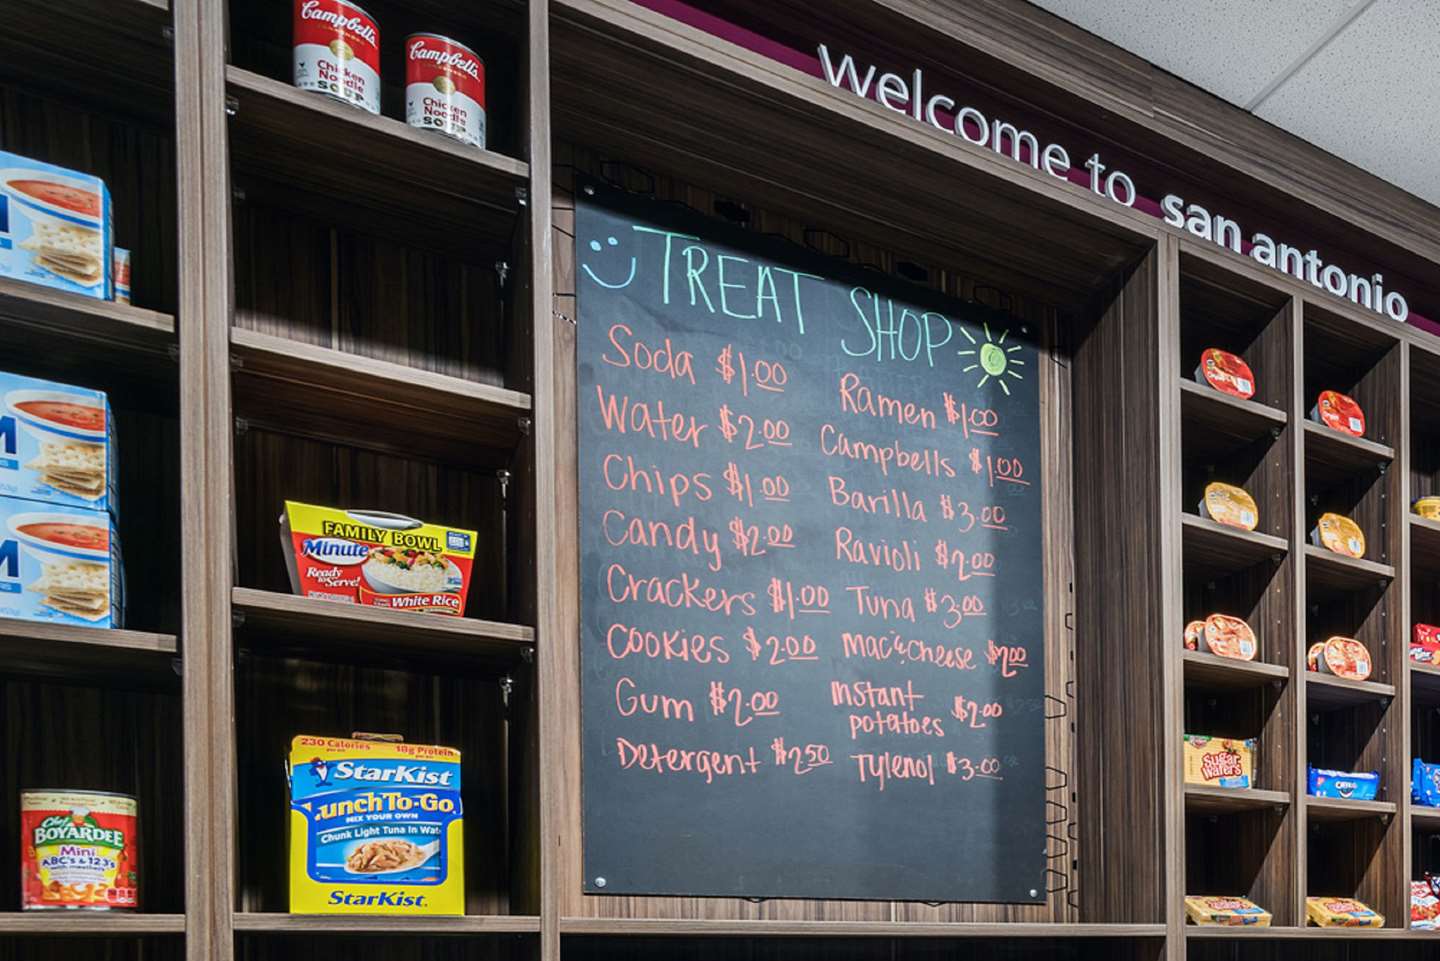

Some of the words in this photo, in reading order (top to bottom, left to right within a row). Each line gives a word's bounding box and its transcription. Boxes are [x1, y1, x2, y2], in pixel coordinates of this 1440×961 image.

[301, 0, 378, 49] Campbell's
[410, 41, 480, 82] Campbell's
[818, 43, 1071, 183] welcome
[1085, 153, 1137, 208] to
[1160, 192, 1242, 256] san
[1251, 231, 1410, 325] antonio
[632, 226, 825, 334] TREAT
[841, 287, 953, 367] SHOP
[602, 324, 696, 385] Soda
[596, 385, 708, 448] Water
[839, 372, 937, 430] Ramen
[820, 424, 957, 478] Campbells
[602, 454, 713, 507] Chips
[828, 476, 928, 522] Barilla
[303, 538, 369, 558] Minute
[323, 520, 387, 547] FAMILY
[392, 531, 442, 552] BOWL
[602, 510, 722, 571] Candy
[835, 527, 921, 571] Ravioli
[392, 596, 430, 608] White
[432, 595, 460, 608] Rice
[607, 564, 756, 617] Crackers
[846, 585, 916, 623] Tuna
[607, 623, 730, 664] Cookies
[615, 678, 694, 722] Gum
[334, 761, 454, 786] StarKist
[617, 737, 761, 784] Detergent
[1203, 752, 1241, 768] Sugar
[34, 827, 124, 848] BOYARDEE
[61, 846, 96, 857] Mini
[321, 831, 352, 844] Chunk
[354, 827, 380, 839] Light
[383, 826, 405, 834] Tuna
[328, 890, 426, 908] StarKist
